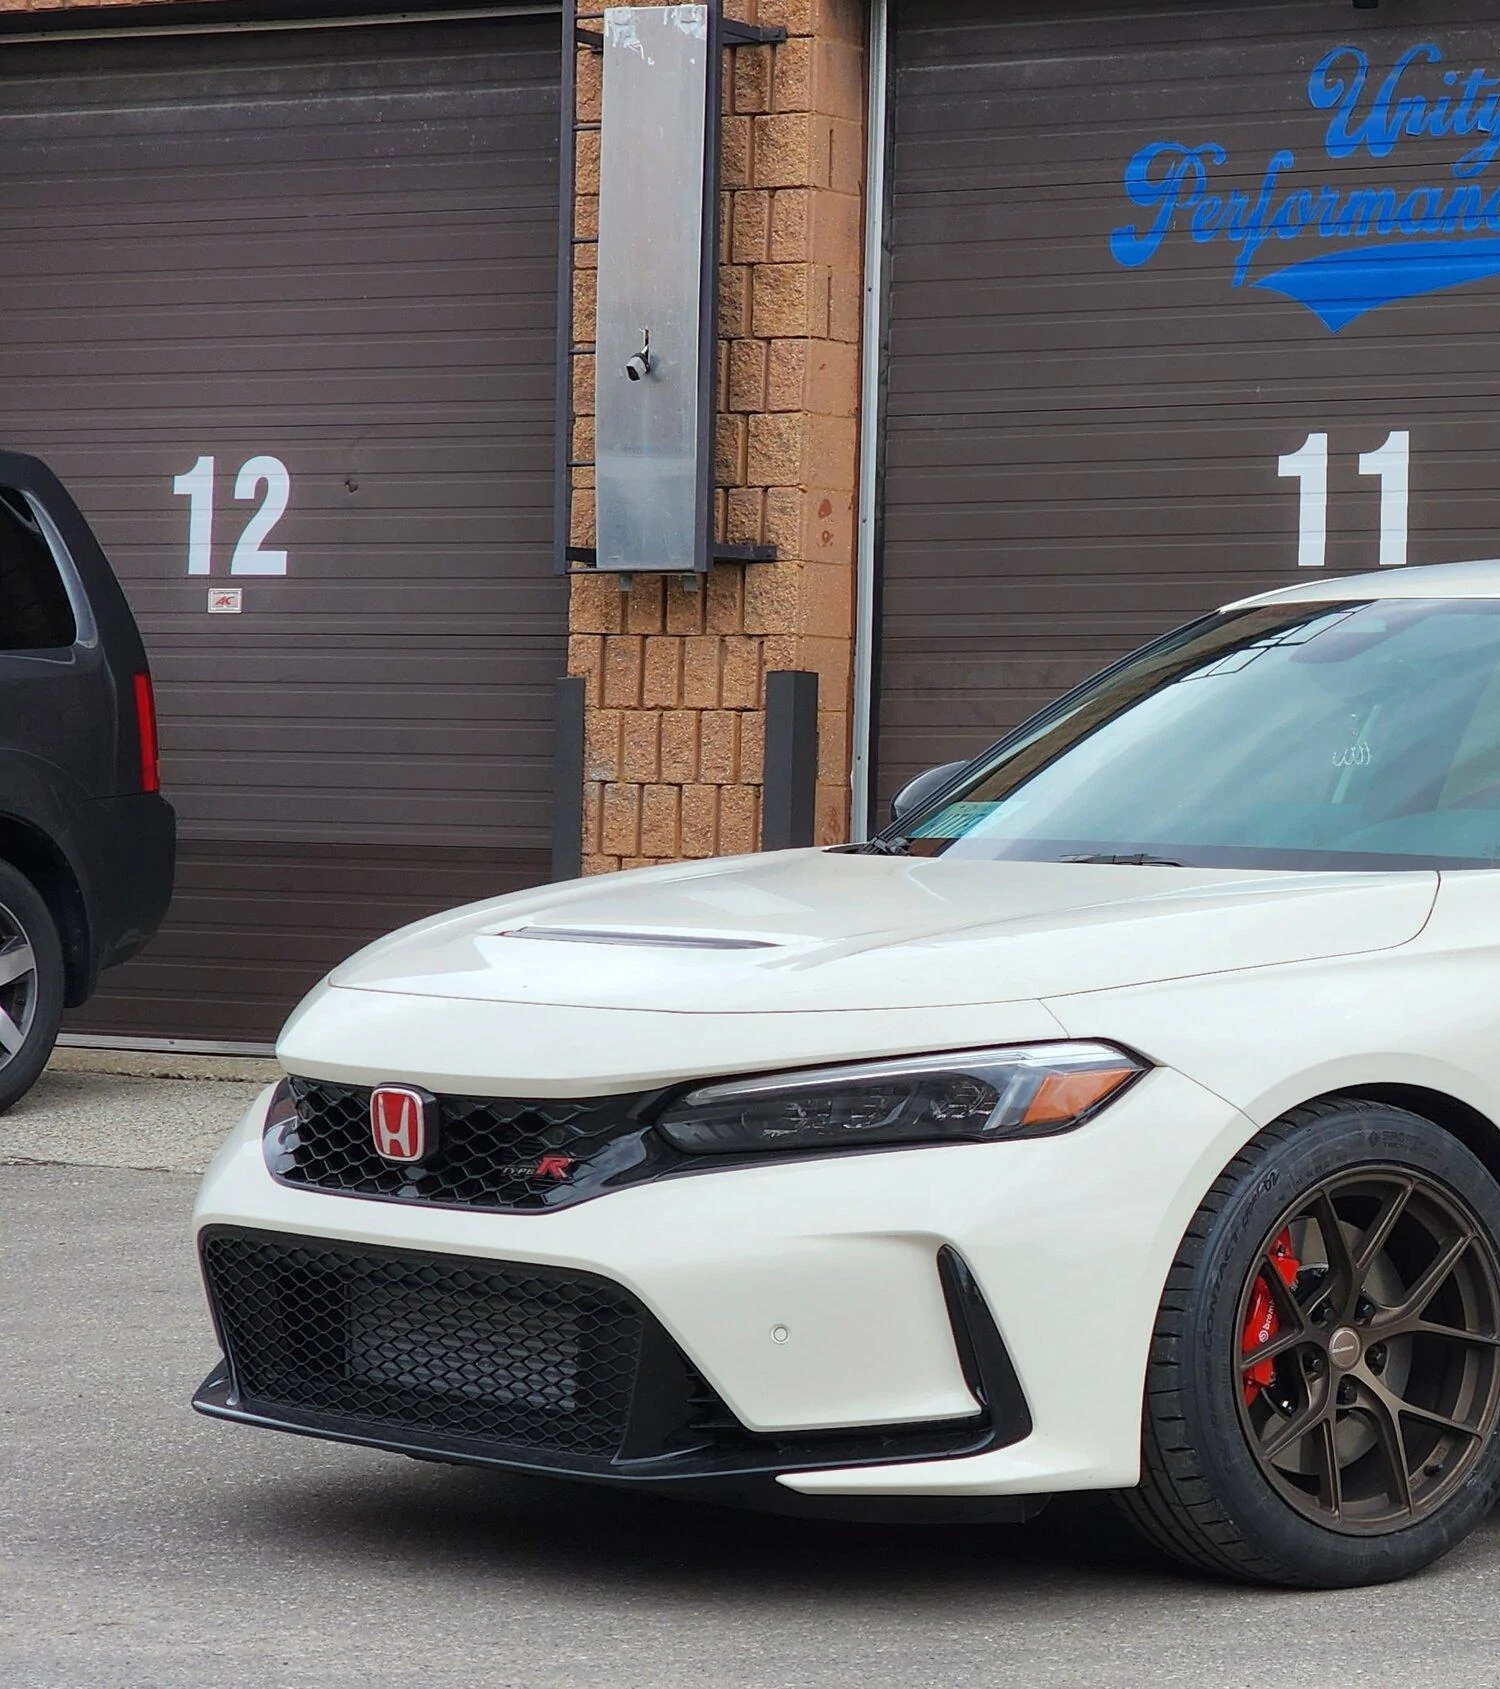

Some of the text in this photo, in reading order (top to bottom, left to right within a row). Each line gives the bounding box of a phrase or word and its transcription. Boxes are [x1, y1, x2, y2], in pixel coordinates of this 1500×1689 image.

[173, 456, 290, 576] 12
[1277, 430, 1410, 567] 11
[533, 1155, 575, 1180] R
